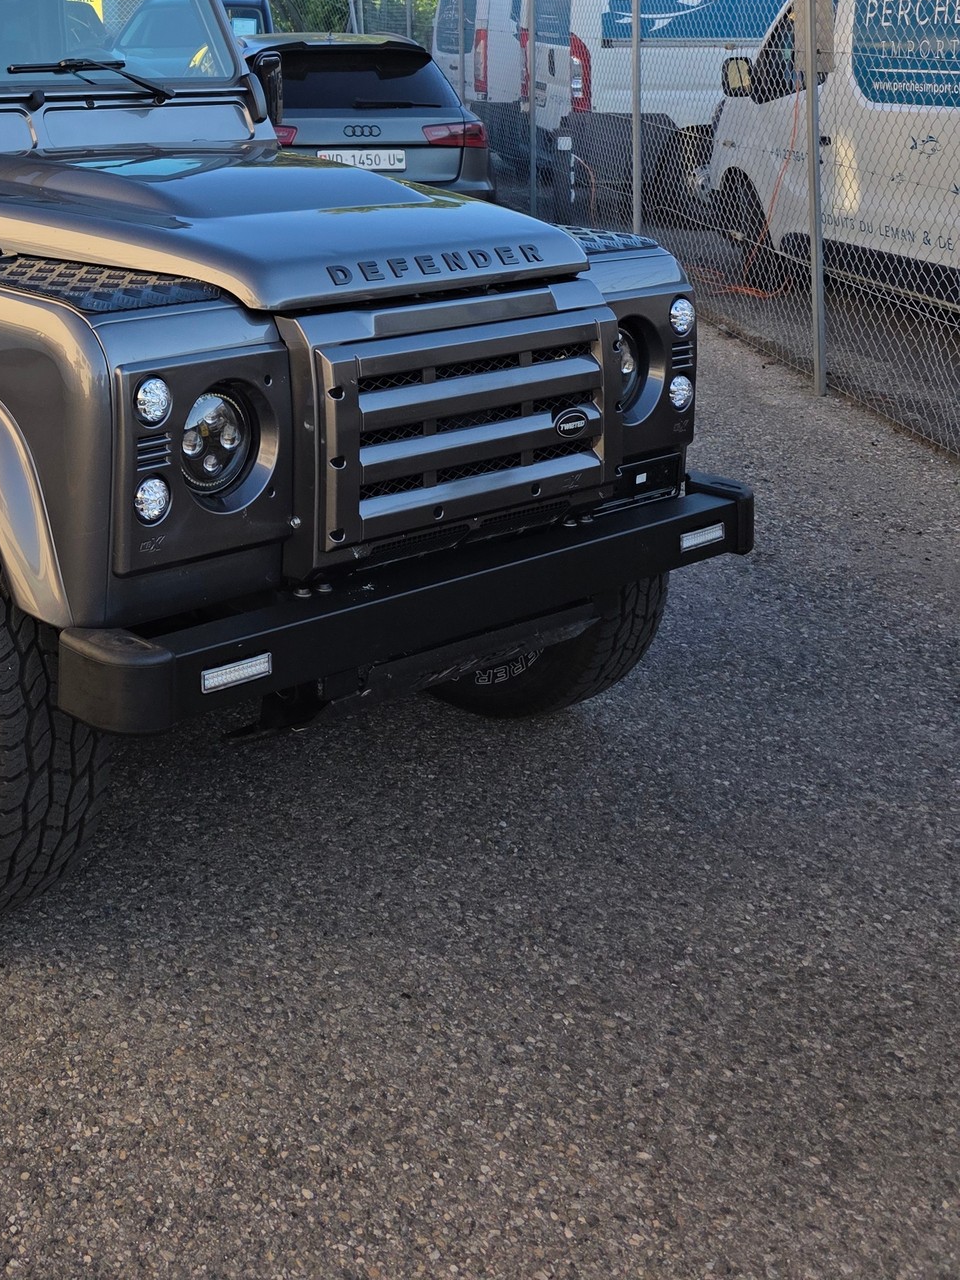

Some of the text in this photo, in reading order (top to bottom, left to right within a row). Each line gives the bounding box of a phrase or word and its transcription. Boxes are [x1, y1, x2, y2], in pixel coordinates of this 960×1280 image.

[881, 40, 960, 59] IMPORT
[351, 153, 381, 167] 1450
[388, 152, 396, 167] U
[326, 244, 544, 286] DEFENDER
